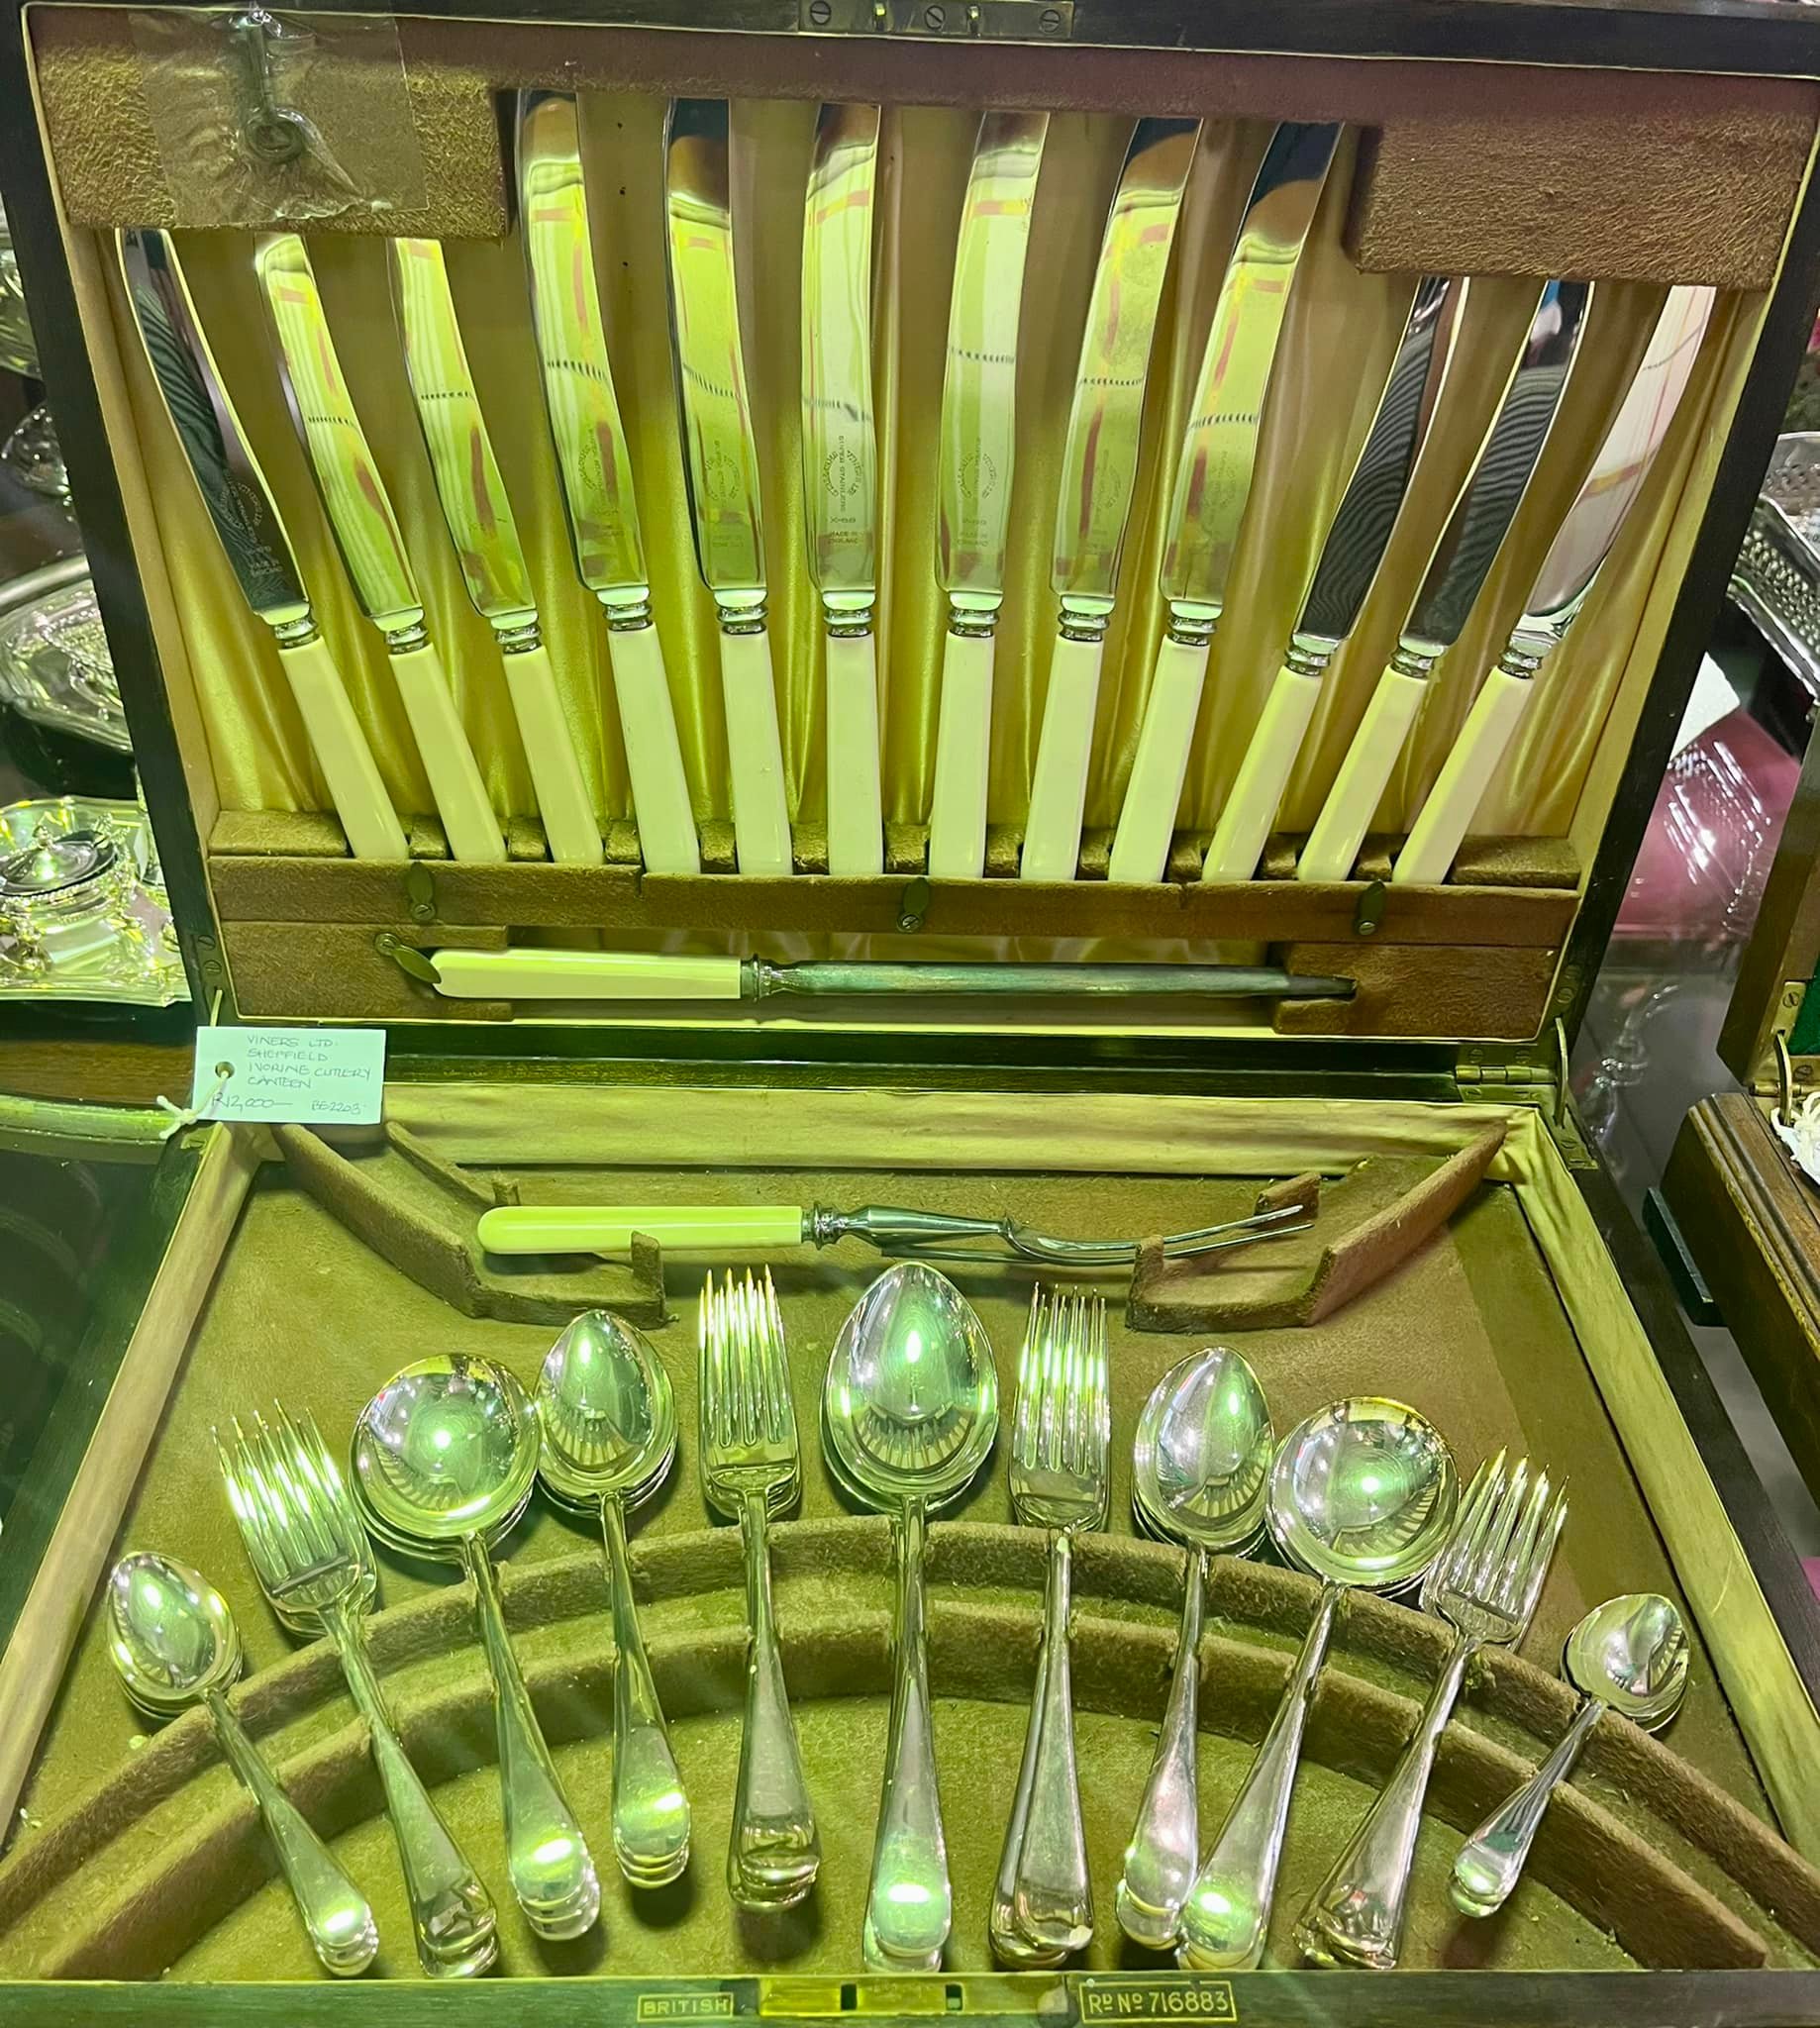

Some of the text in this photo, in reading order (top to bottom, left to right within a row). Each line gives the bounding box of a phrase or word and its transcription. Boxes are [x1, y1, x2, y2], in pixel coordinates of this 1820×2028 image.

[247, 1035, 300, 1047] VINERS
[643, 1997, 729, 2016] BRITISH
[1148, 1990, 1229, 2012] 716883
